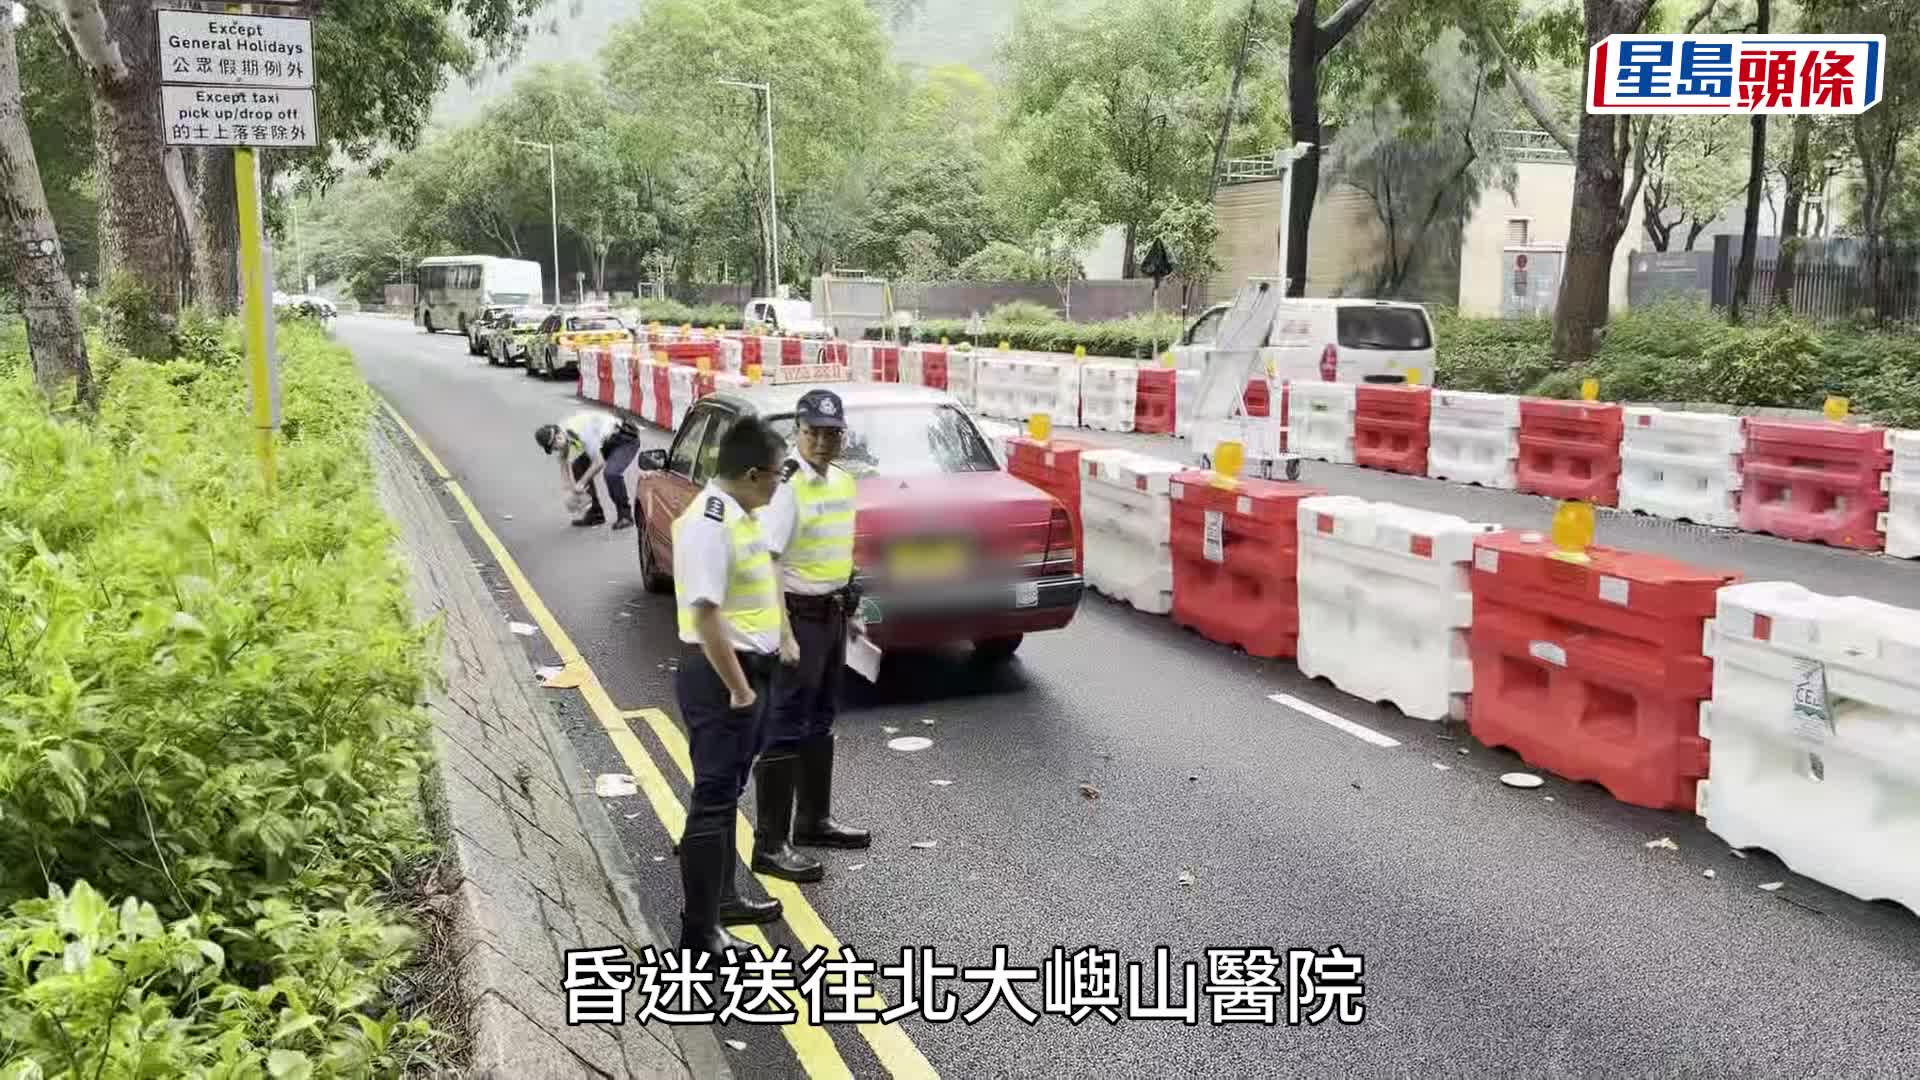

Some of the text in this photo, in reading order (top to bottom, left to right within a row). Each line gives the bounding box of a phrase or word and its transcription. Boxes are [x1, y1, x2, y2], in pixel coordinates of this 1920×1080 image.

[209, 21, 263, 37] Except
[169, 35, 303, 56] General Holidays
[172, 56, 303, 78] 公眾假期例外
[196, 91, 279, 104] Except taxi
[179, 108, 297, 121] pick up/drop off
[172, 123, 306, 140] 的士上落客除外
